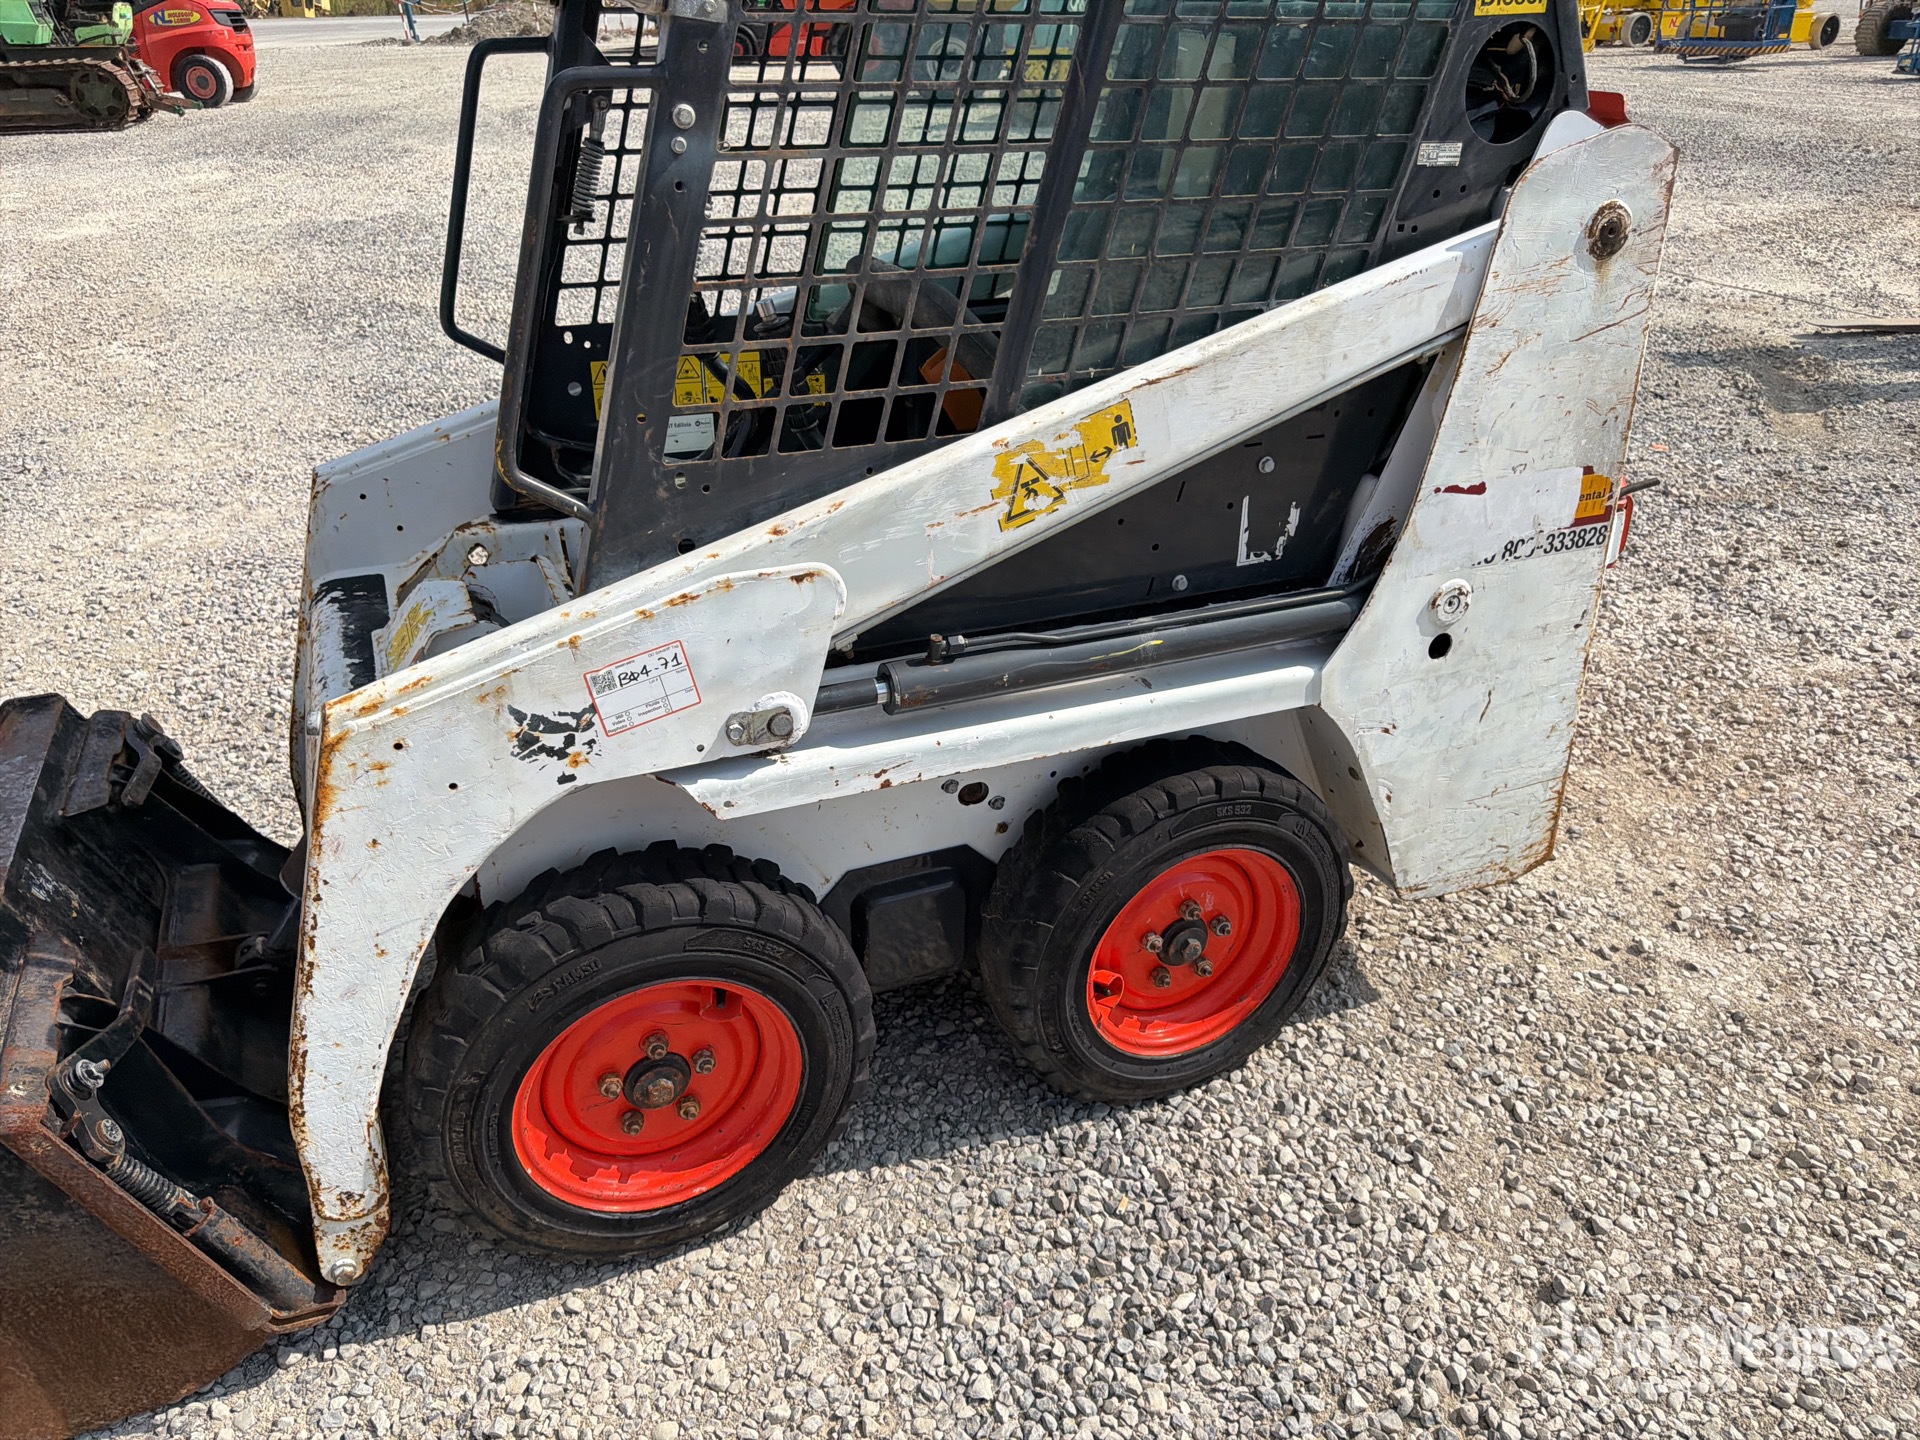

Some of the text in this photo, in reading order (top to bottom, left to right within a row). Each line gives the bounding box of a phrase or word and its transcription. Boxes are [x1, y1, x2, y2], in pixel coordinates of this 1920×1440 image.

[154, 8, 173, 26] NL
[1579, 487, 1607, 501] ental
[638, 706, 662, 716] Inspection
[1216, 805, 1234, 818] SKS
